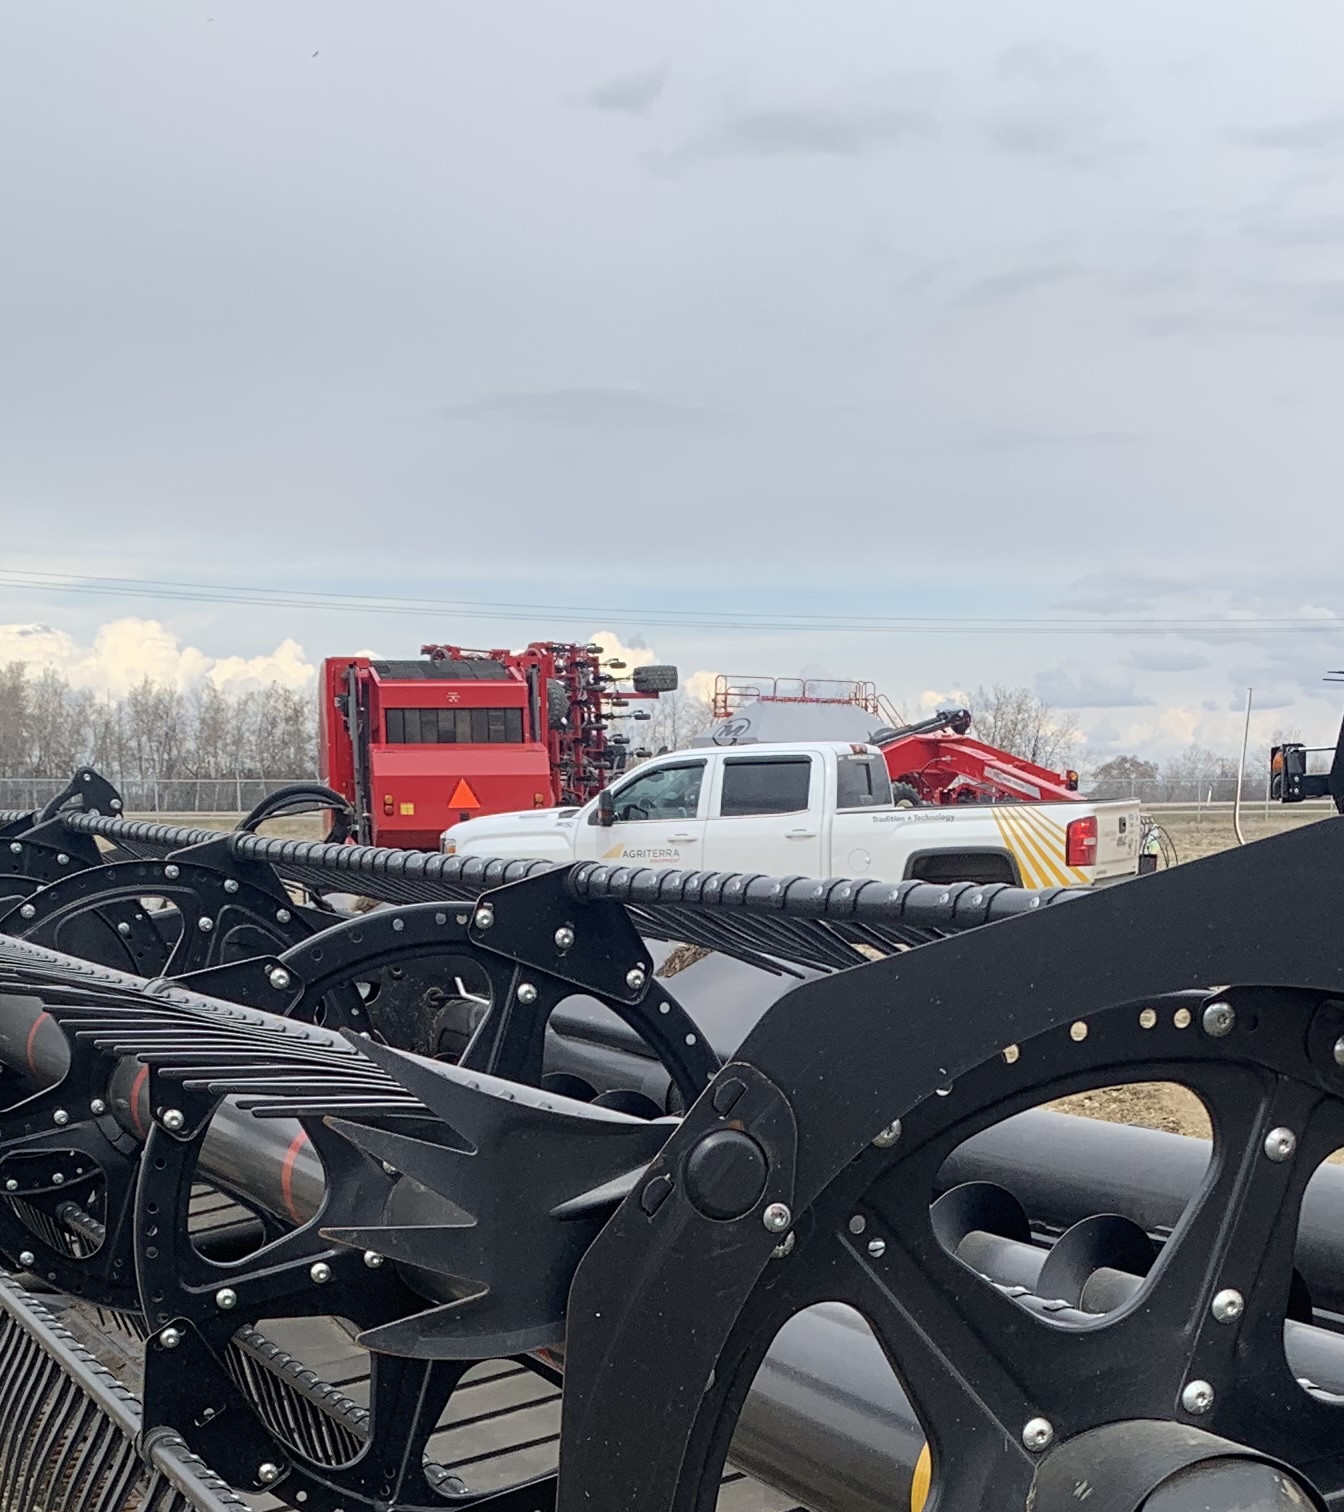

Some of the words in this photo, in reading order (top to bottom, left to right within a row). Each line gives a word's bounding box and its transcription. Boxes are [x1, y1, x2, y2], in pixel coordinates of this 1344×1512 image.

[872, 815, 906, 823] Tradition
[913, 813, 955, 823] Technology
[622, 848, 681, 859] AGRITERRA
